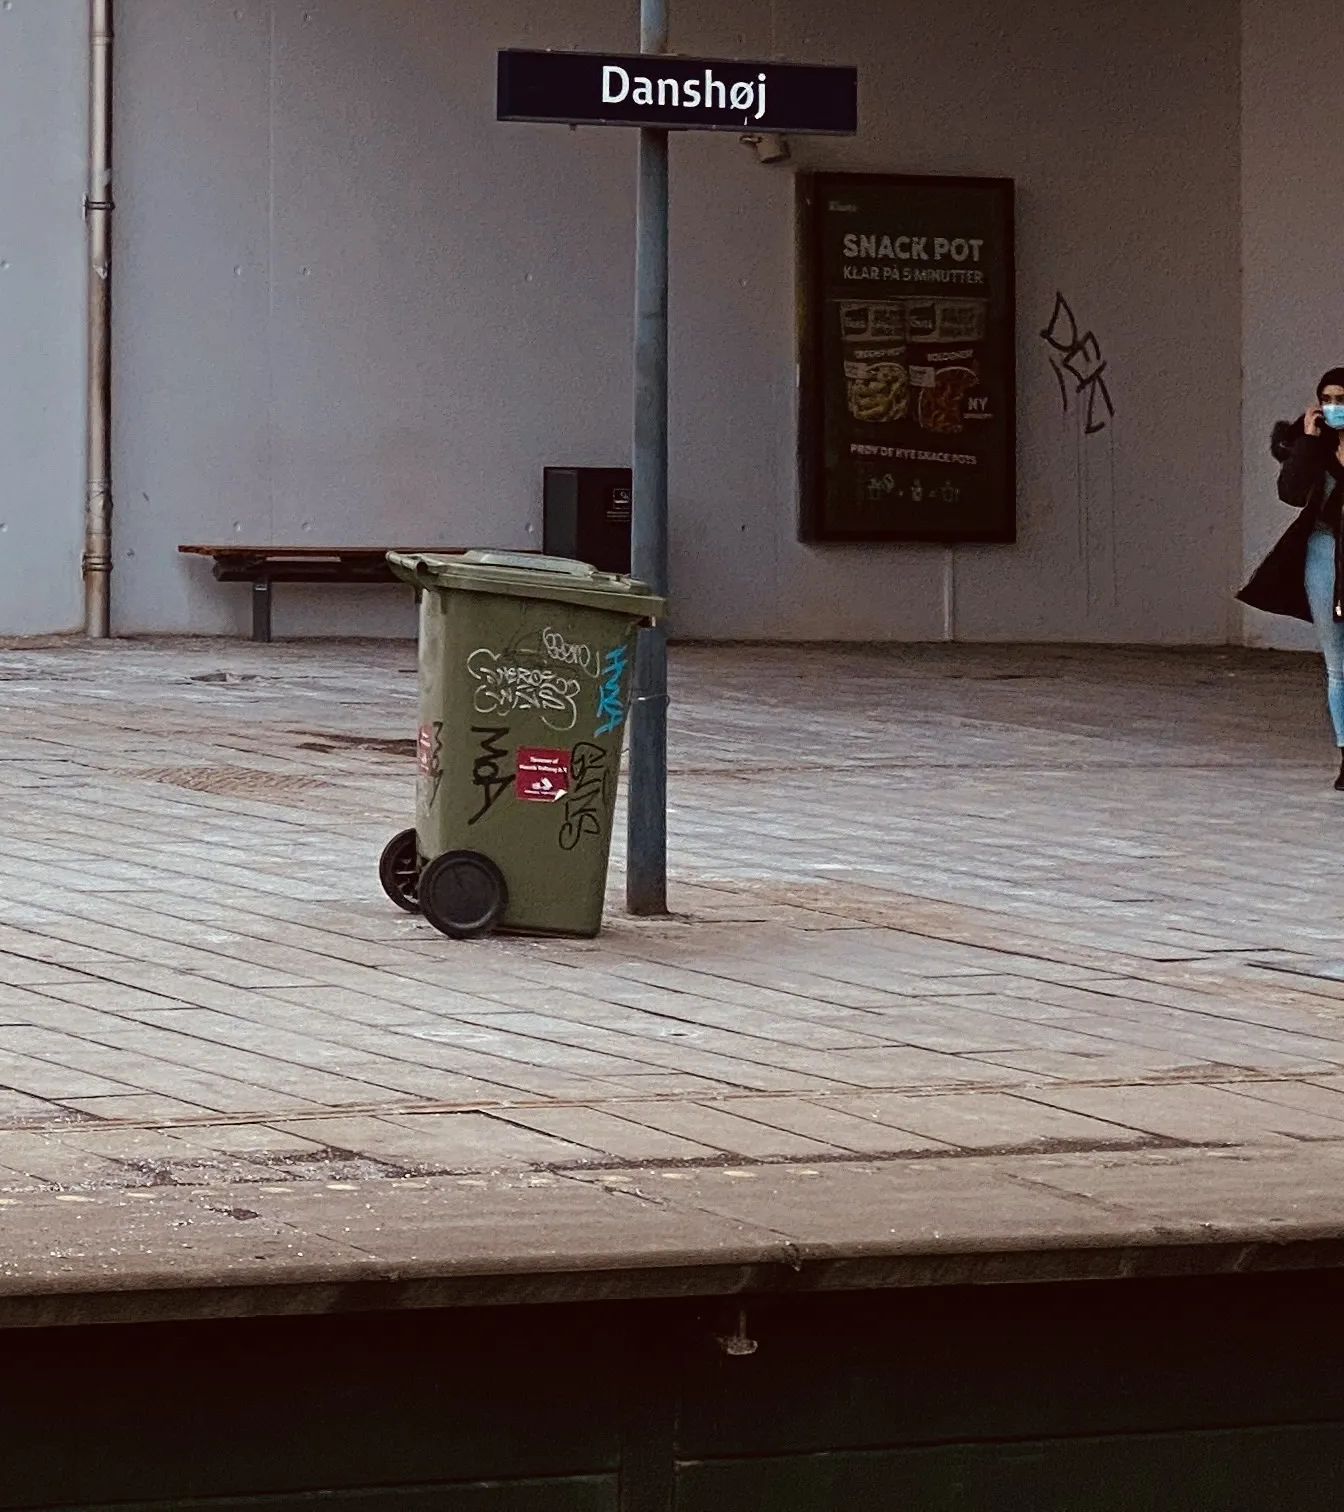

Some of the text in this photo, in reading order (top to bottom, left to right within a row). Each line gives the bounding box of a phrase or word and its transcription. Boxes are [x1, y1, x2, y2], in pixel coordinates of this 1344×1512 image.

[602, 65, 766, 120] Danshøj
[842, 232, 984, 262] SNACK POT
[843, 264, 880, 280] KLAR
